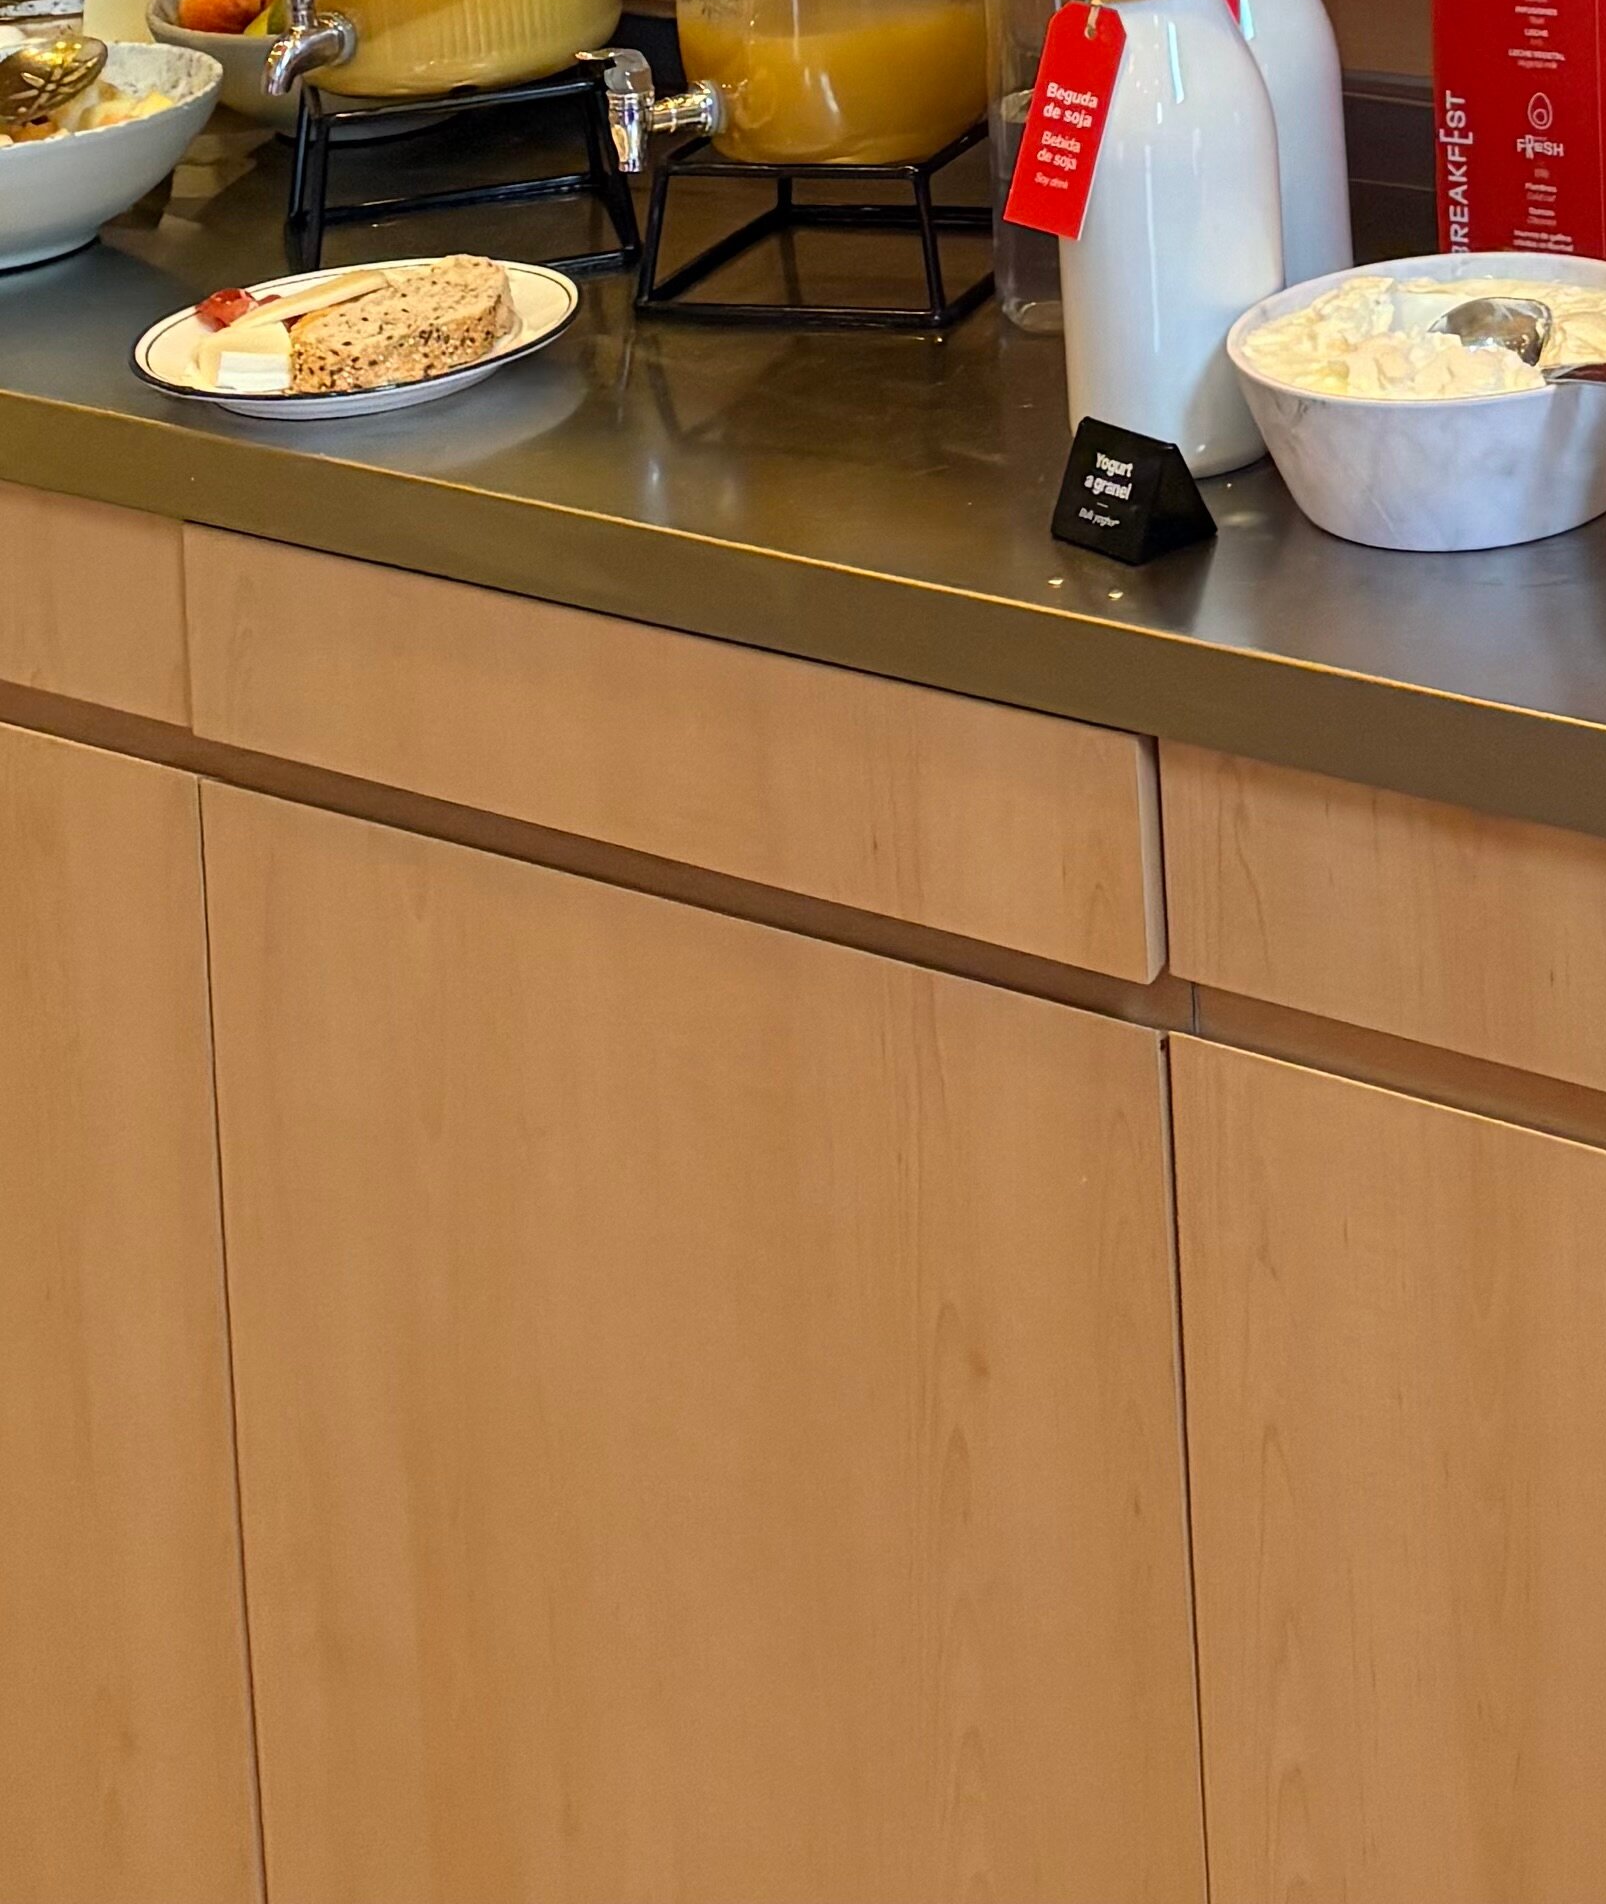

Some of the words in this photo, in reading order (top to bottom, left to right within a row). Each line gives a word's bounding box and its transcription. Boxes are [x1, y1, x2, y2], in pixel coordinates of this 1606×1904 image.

[1046, 81, 1098, 109] Beguda
[1043, 102, 1061, 120] de
[1063, 109, 1093, 129] soja
[1041, 130, 1081, 154] Bebida
[1096, 452, 1134, 478] Yogurt
[1092, 477, 1133, 501] granel
